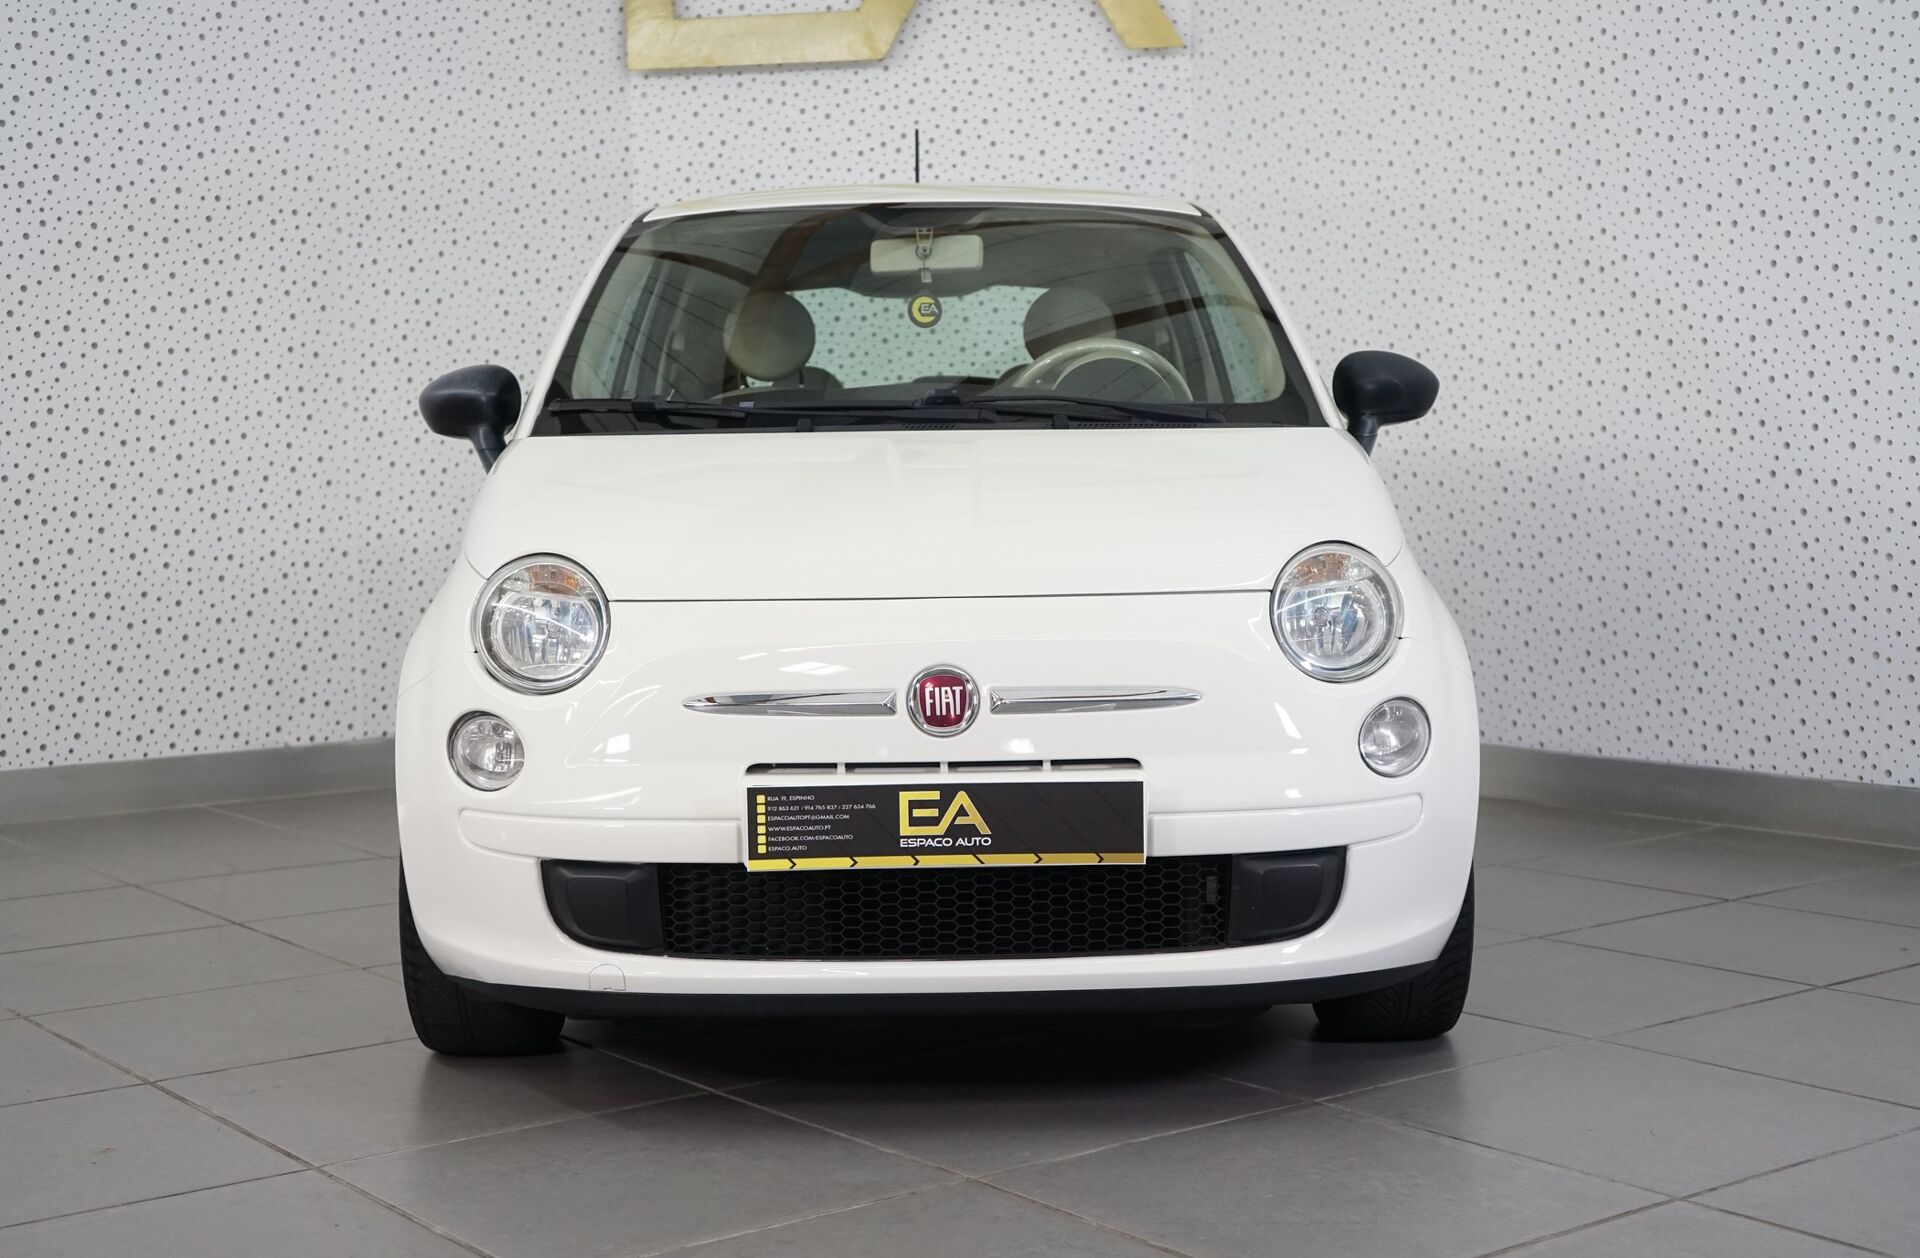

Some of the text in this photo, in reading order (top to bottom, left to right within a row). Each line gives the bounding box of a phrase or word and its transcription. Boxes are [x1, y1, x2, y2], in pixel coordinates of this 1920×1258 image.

[924, 686, 963, 717] FIAT
[899, 791, 992, 836] EA
[768, 834, 853, 842] FACEBOOK.COM/ESPACOAUTO
[900, 837, 992, 848] ESPACO AUTO
